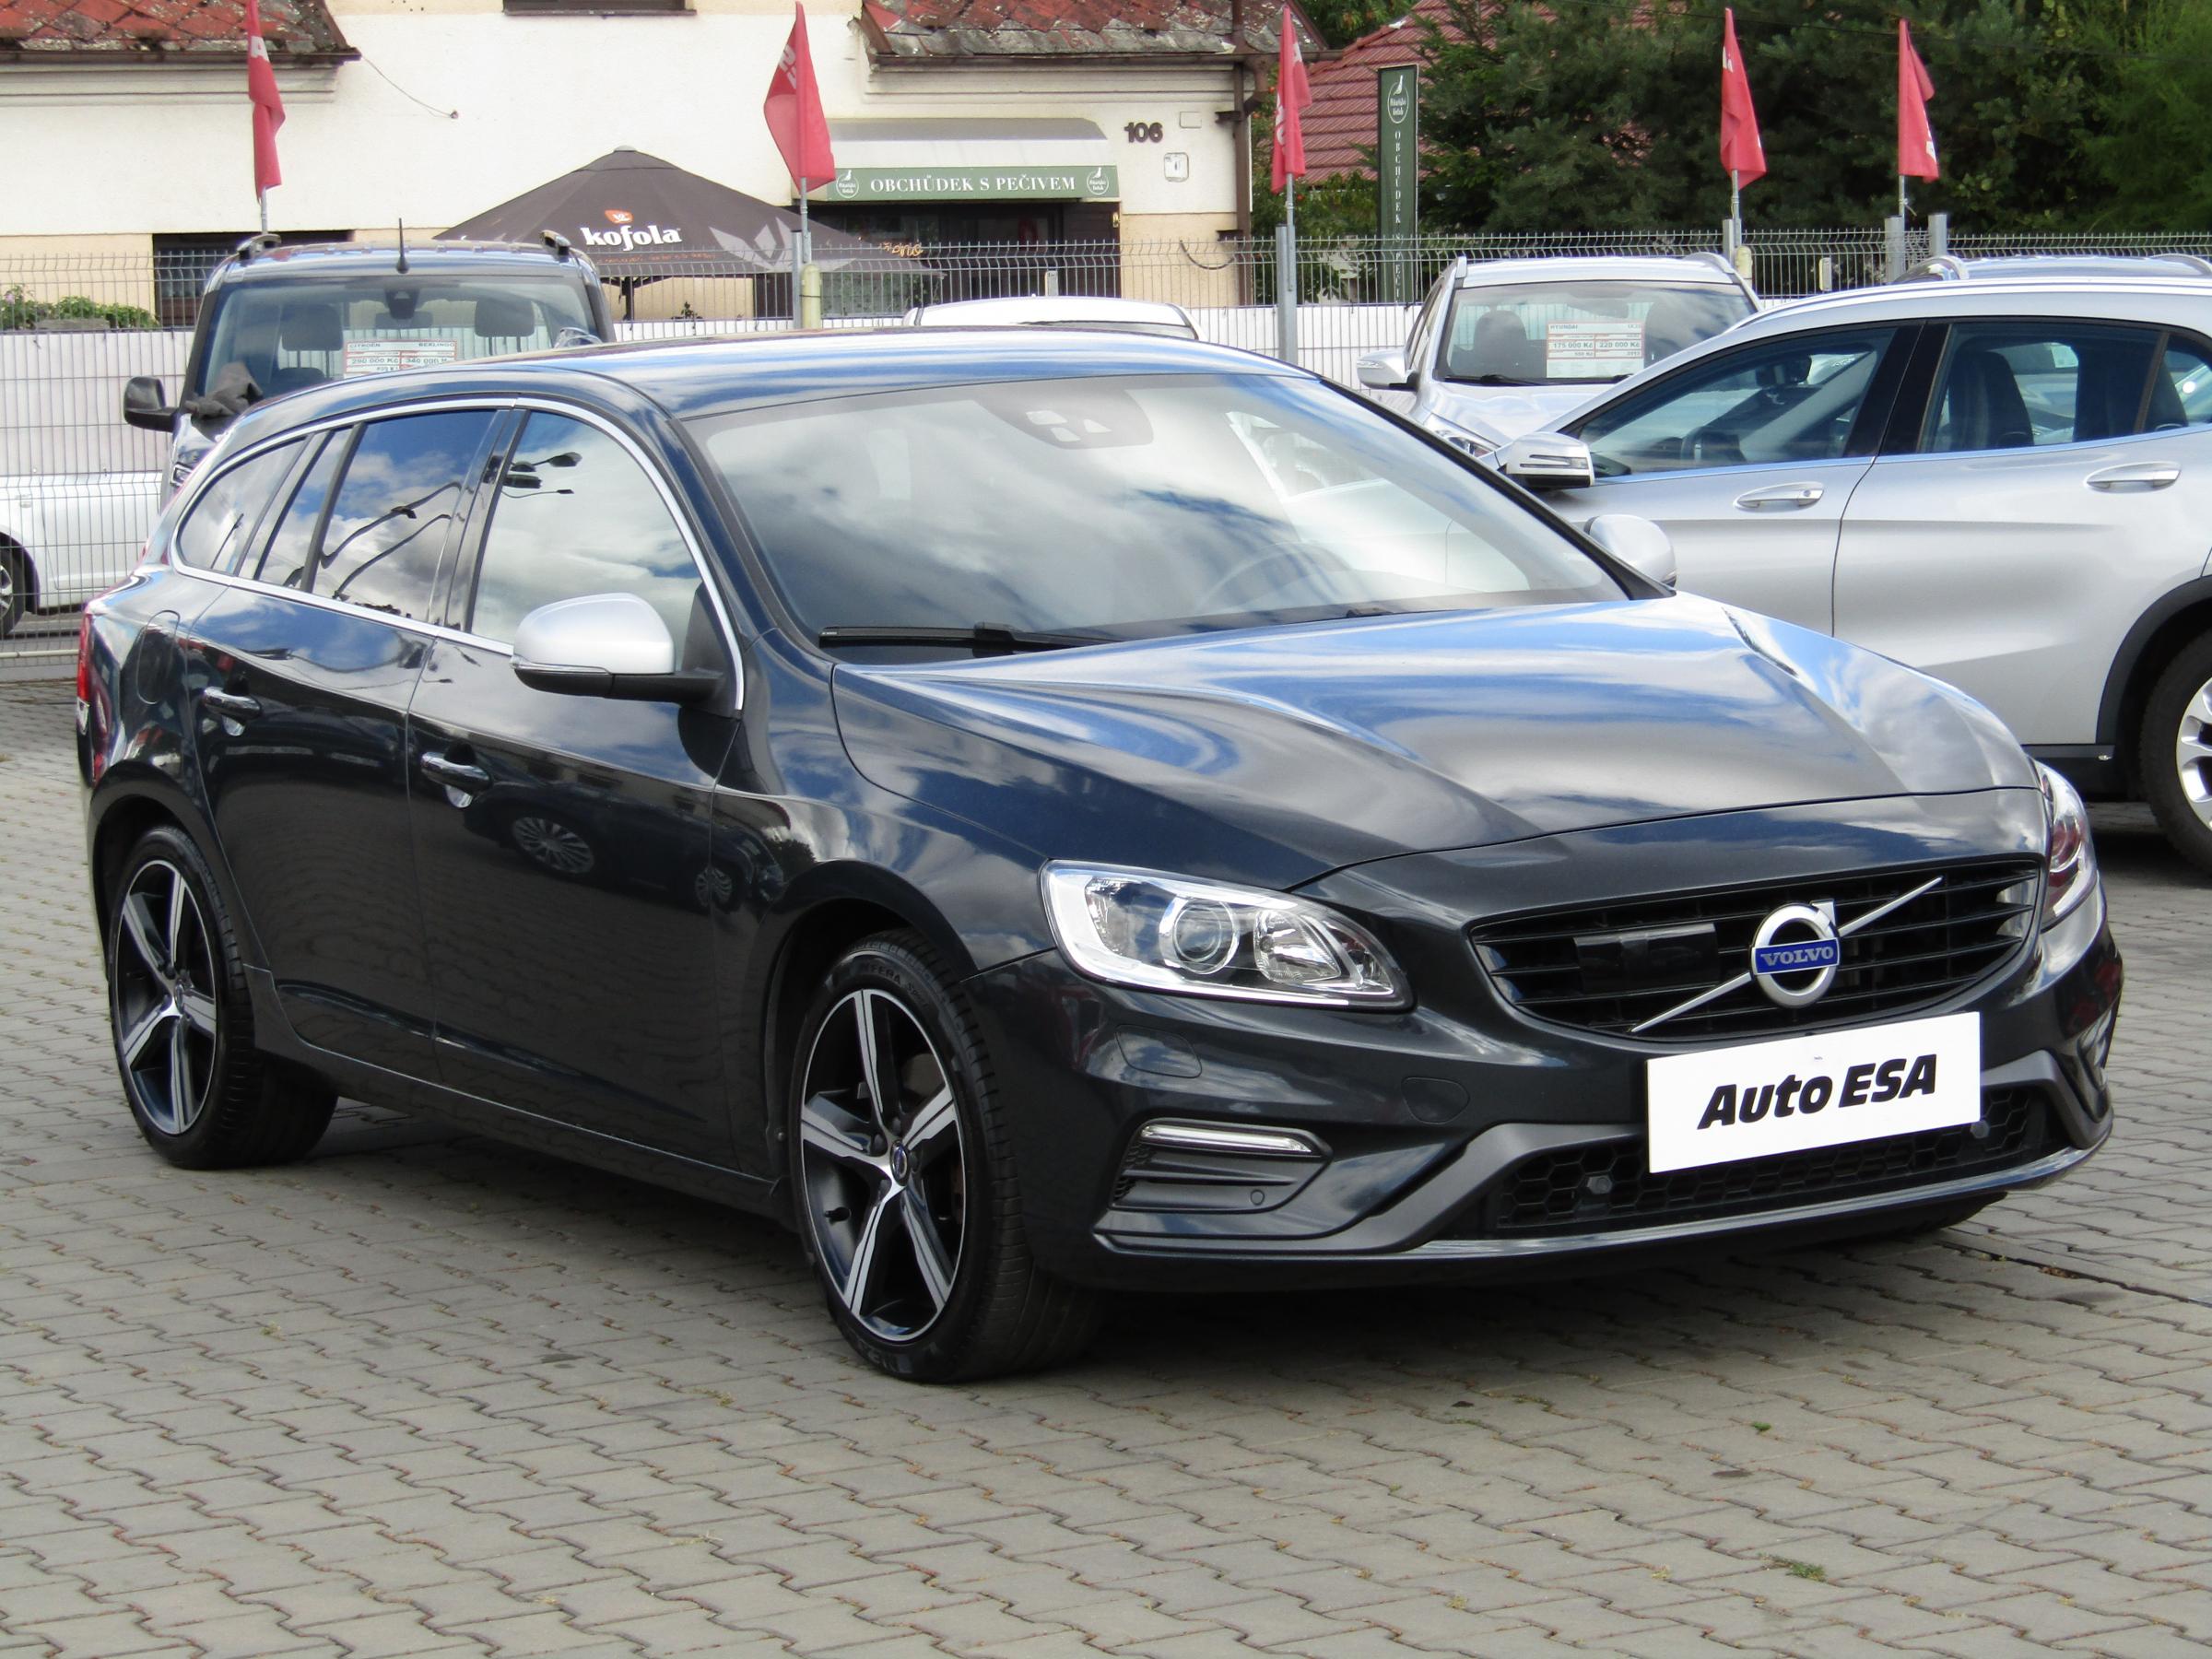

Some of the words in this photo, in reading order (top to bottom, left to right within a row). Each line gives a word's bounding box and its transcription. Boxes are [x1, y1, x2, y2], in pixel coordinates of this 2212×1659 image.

[1124, 122, 1163, 143] 106
[870, 174, 973, 193] OBCHŮDEK
[980, 177, 990, 191] S
[996, 173, 1076, 191] PEČIVEM
[580, 224, 683, 252] kofola
[1760, 947, 1834, 966] VOLVO
[1697, 1074, 1833, 1130] Auto
[1838, 1053, 1936, 1108] ESA
